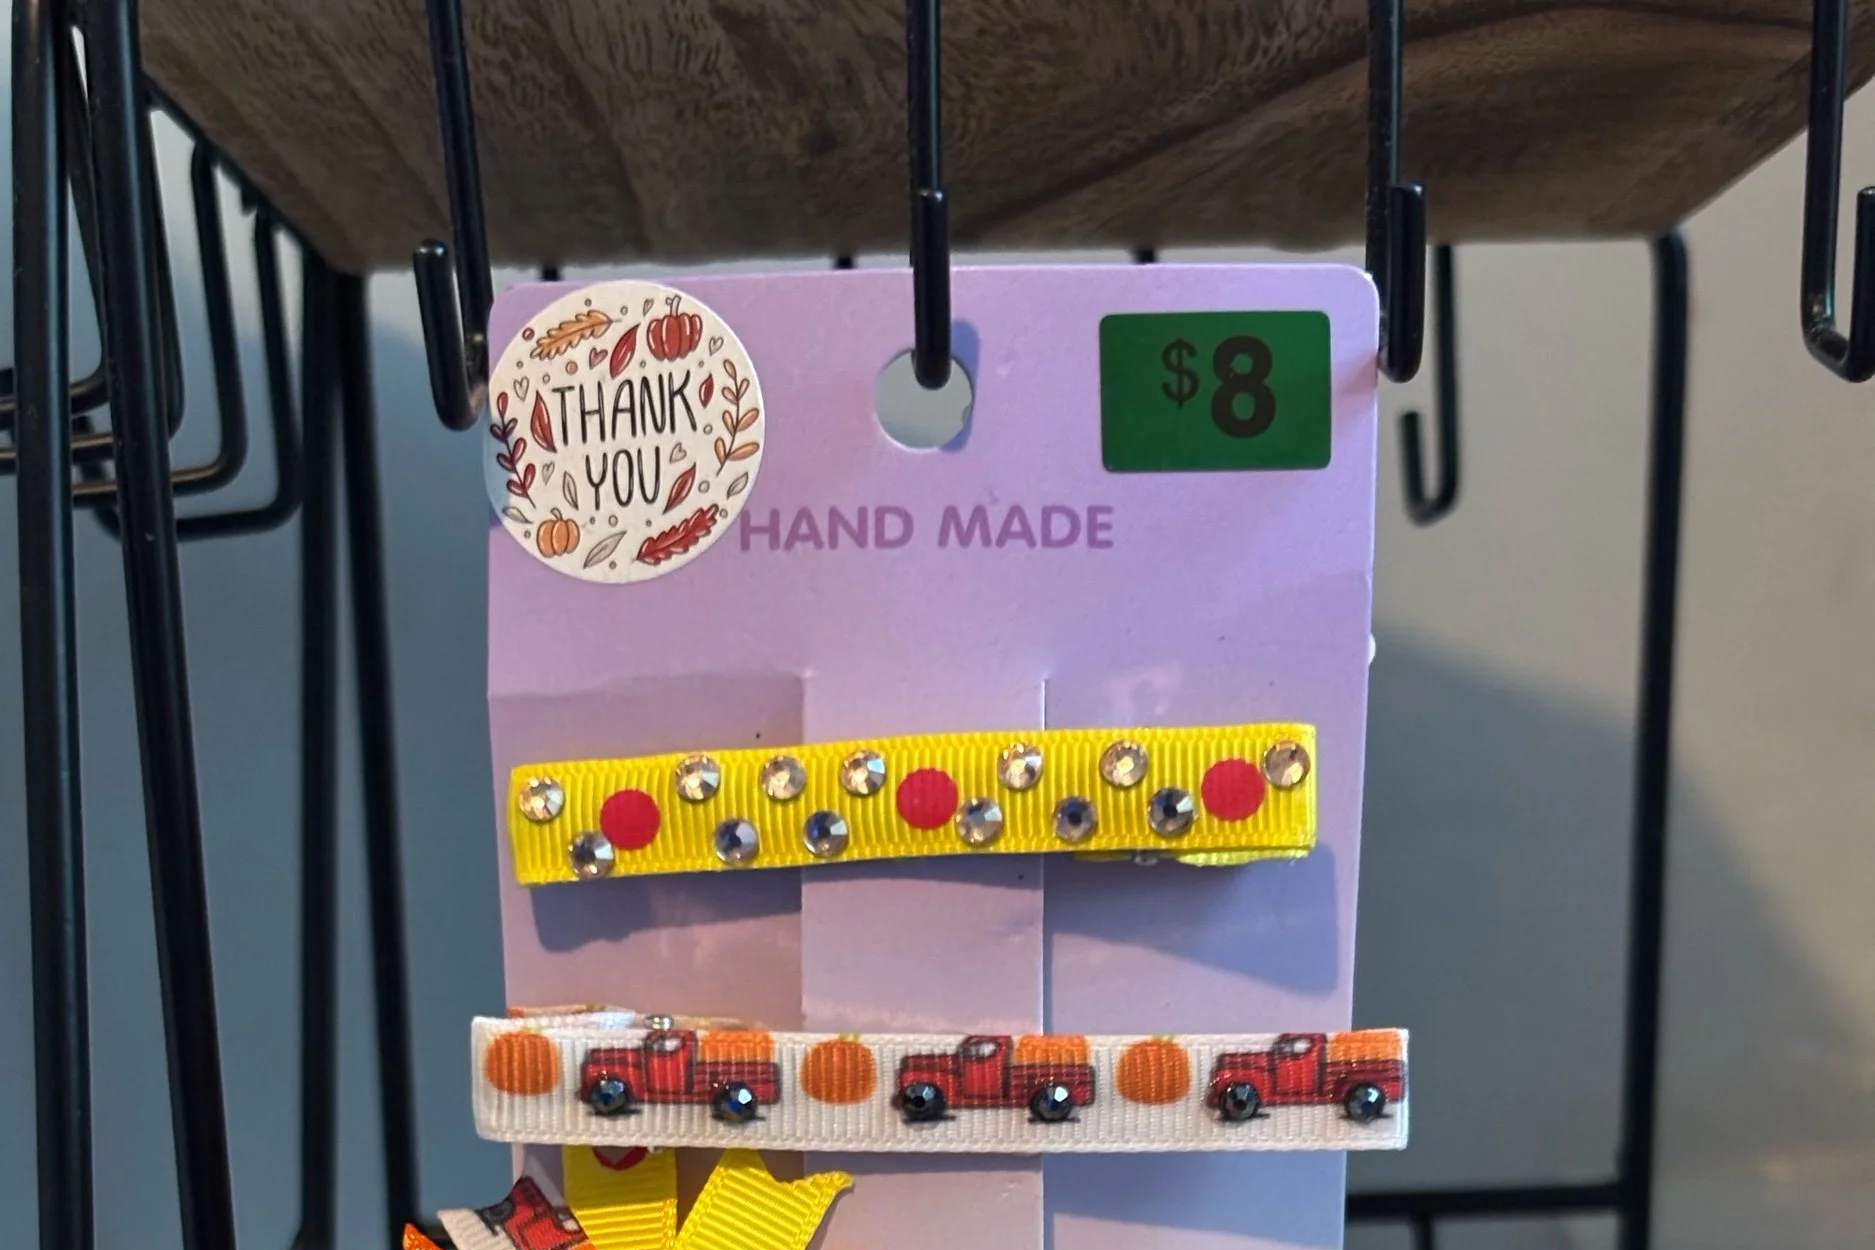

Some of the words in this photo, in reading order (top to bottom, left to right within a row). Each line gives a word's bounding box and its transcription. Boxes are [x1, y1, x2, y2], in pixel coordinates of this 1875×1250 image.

[551, 369, 698, 447] THANK
[1161, 334, 1276, 439] $8
[584, 445, 661, 512] YOU
[739, 505, 915, 552] HAND
[937, 504, 1114, 550] MADE
